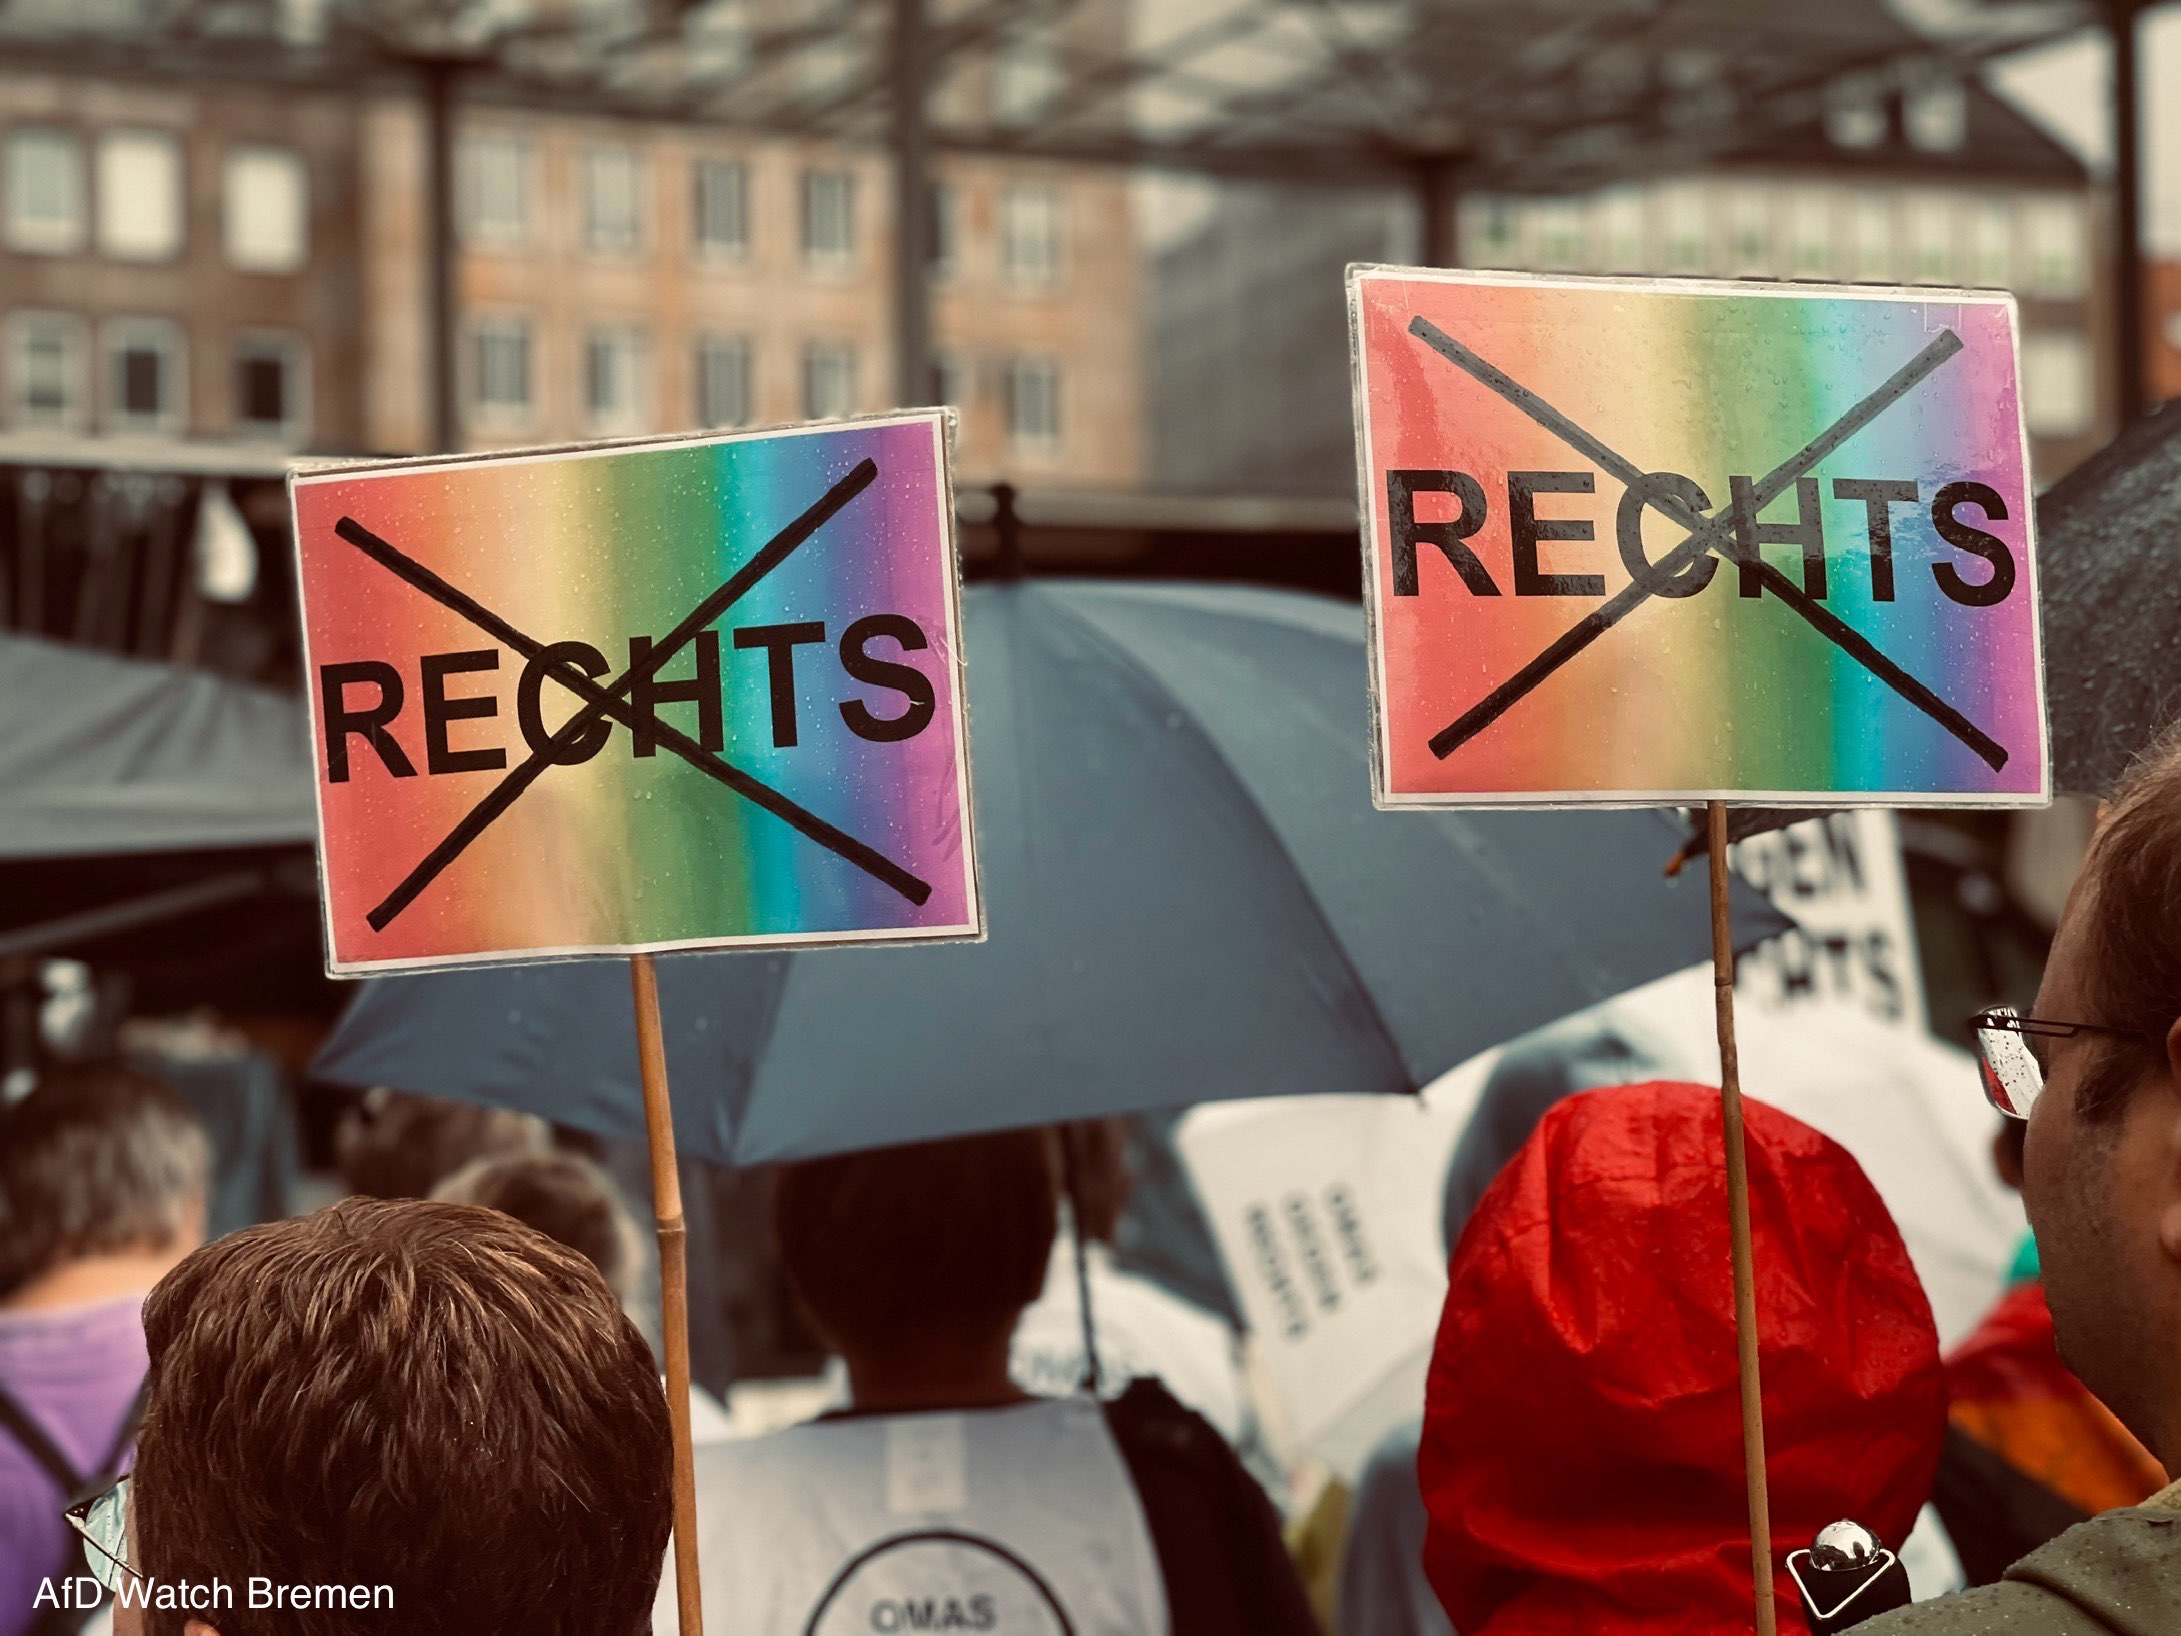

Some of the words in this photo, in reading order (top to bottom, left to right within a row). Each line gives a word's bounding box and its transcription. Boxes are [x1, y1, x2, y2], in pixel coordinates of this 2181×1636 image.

[1386, 469, 2017, 607] RECHTS
[318, 613, 937, 783] RECHTS
[870, 1594, 997, 1633] OMAS
